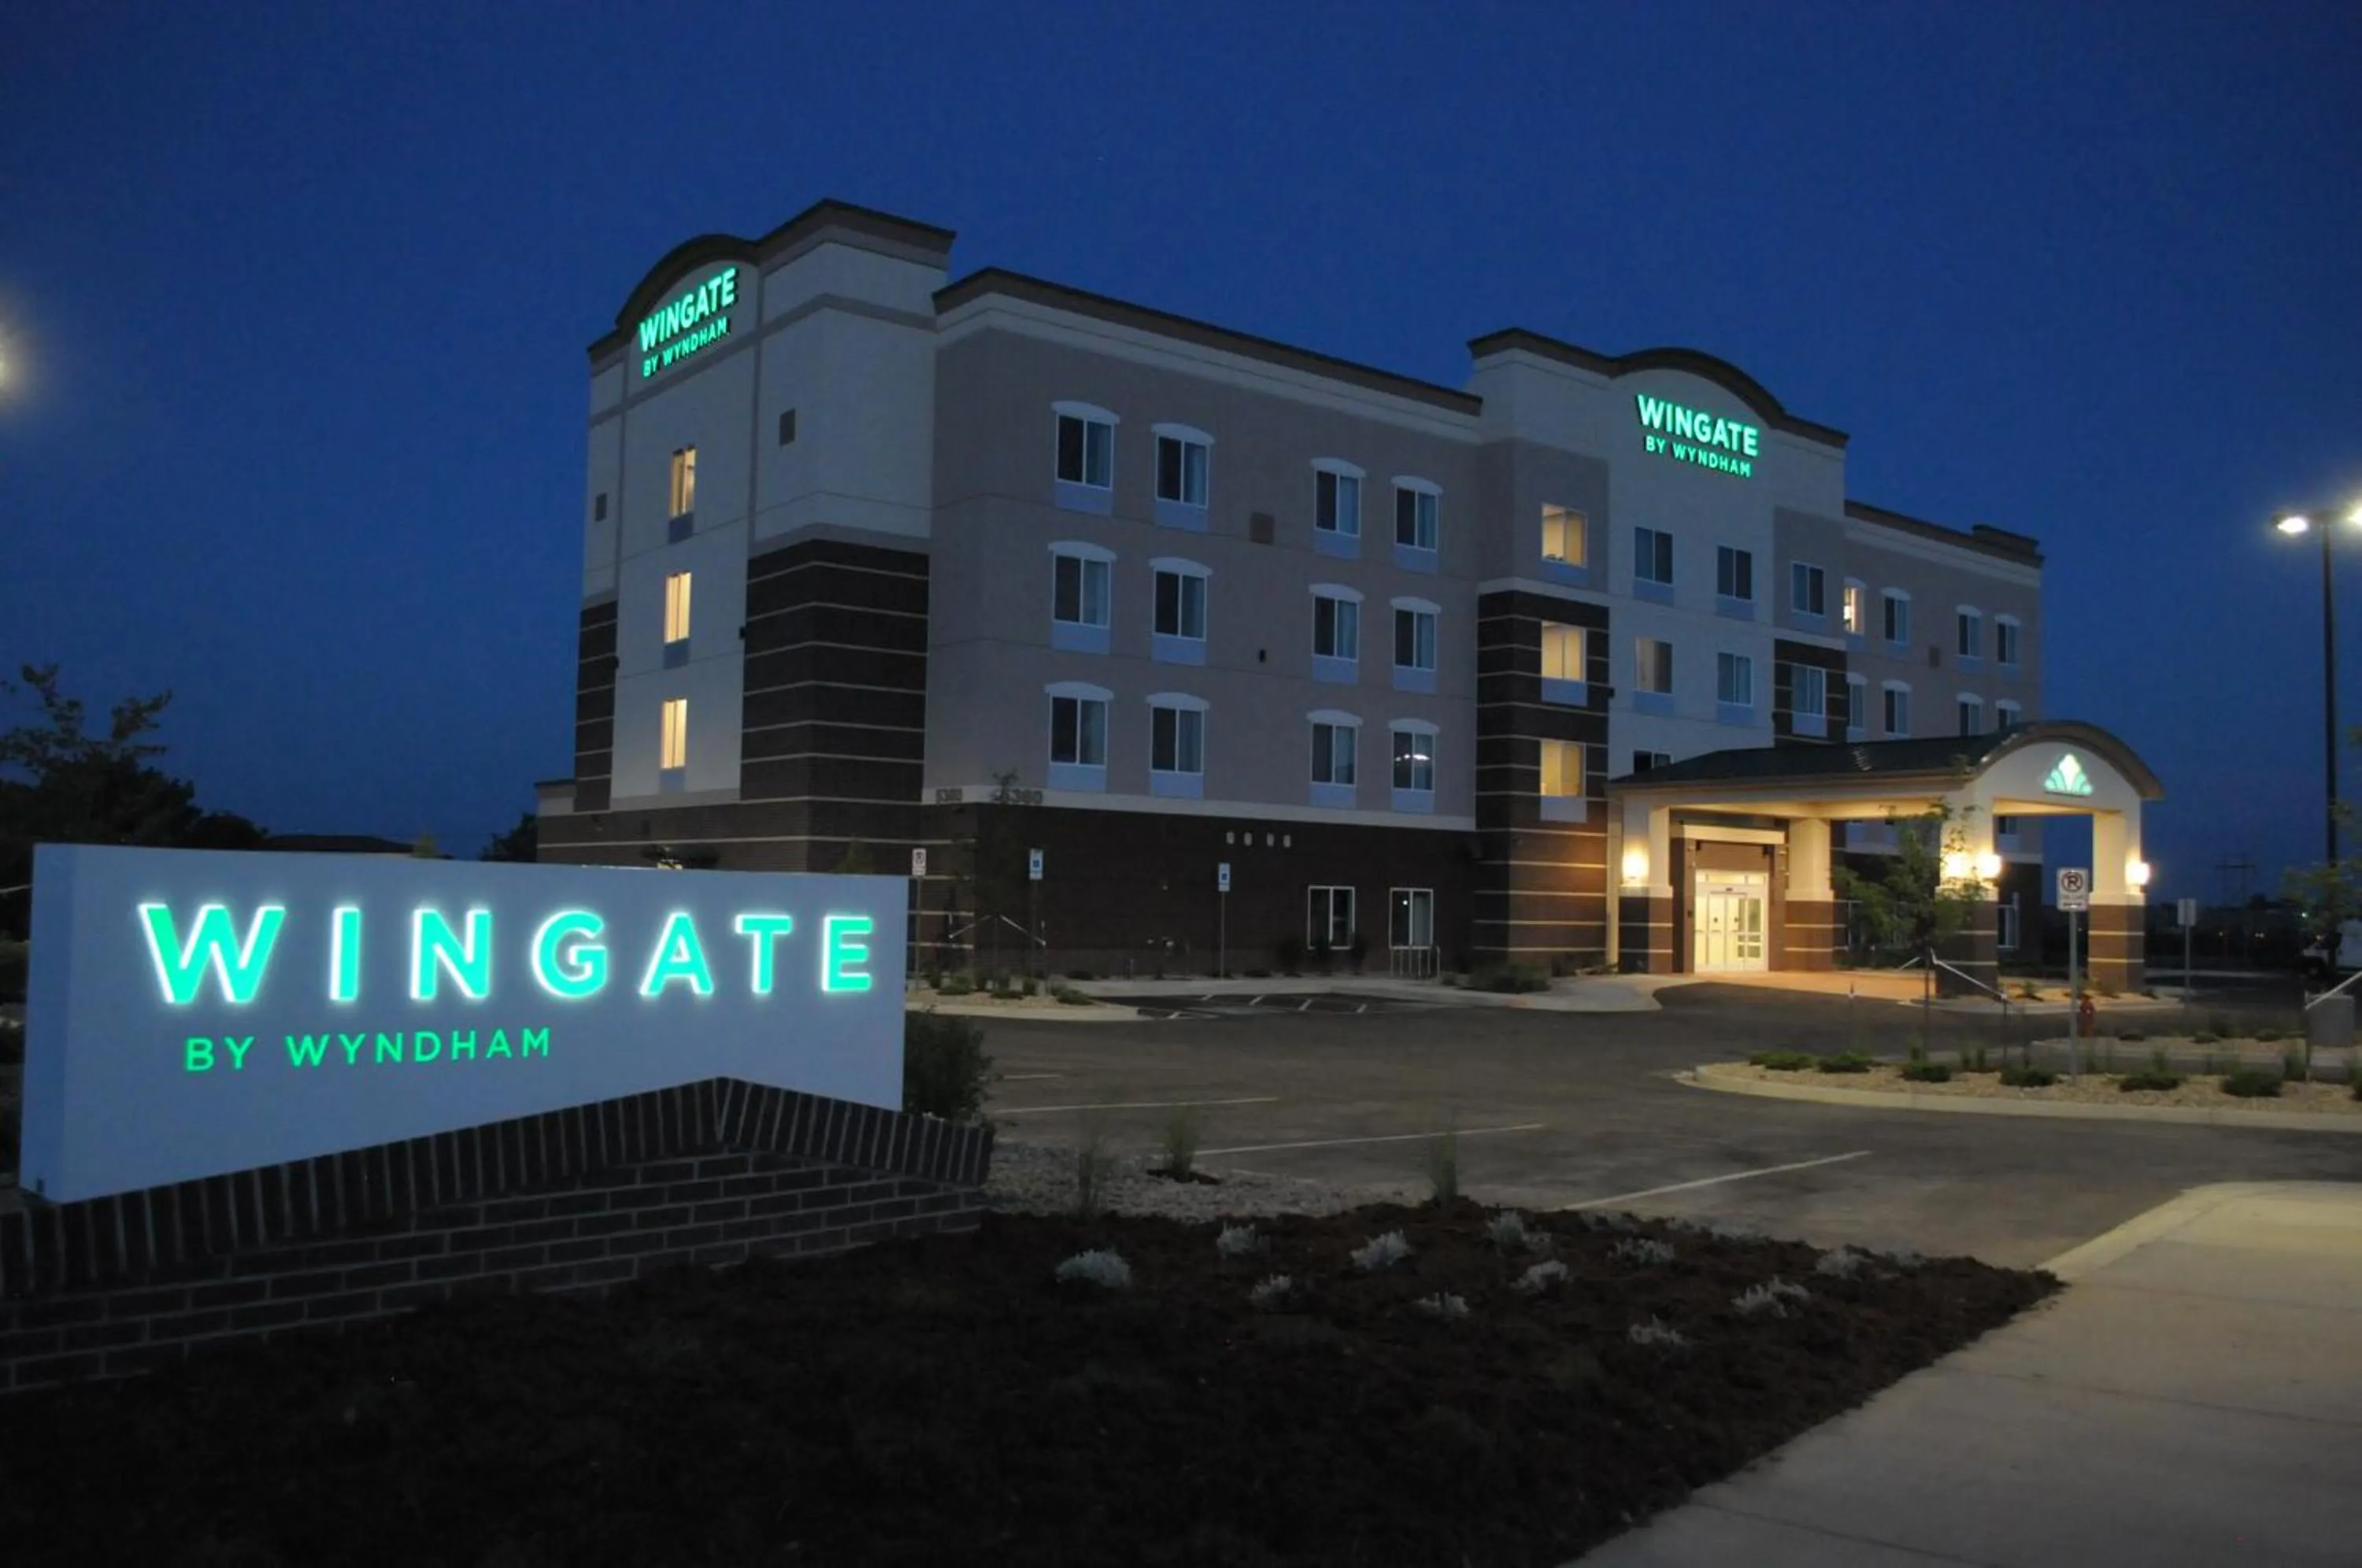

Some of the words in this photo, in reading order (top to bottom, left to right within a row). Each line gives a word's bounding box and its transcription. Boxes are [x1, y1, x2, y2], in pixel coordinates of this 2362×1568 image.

[639, 267, 737, 353] WINGATE
[642, 354, 659, 378] BY
[661, 316, 728, 367] WYNDHAM
[1637, 393, 1760, 457] WINGATE
[1645, 435, 1667, 454] BY
[1672, 441, 1753, 479] WYNDHAM
[139, 904, 875, 1004] WINGATE
[183, 1034, 256, 1073] BY
[282, 1026, 552, 1070] WYNDHAM
